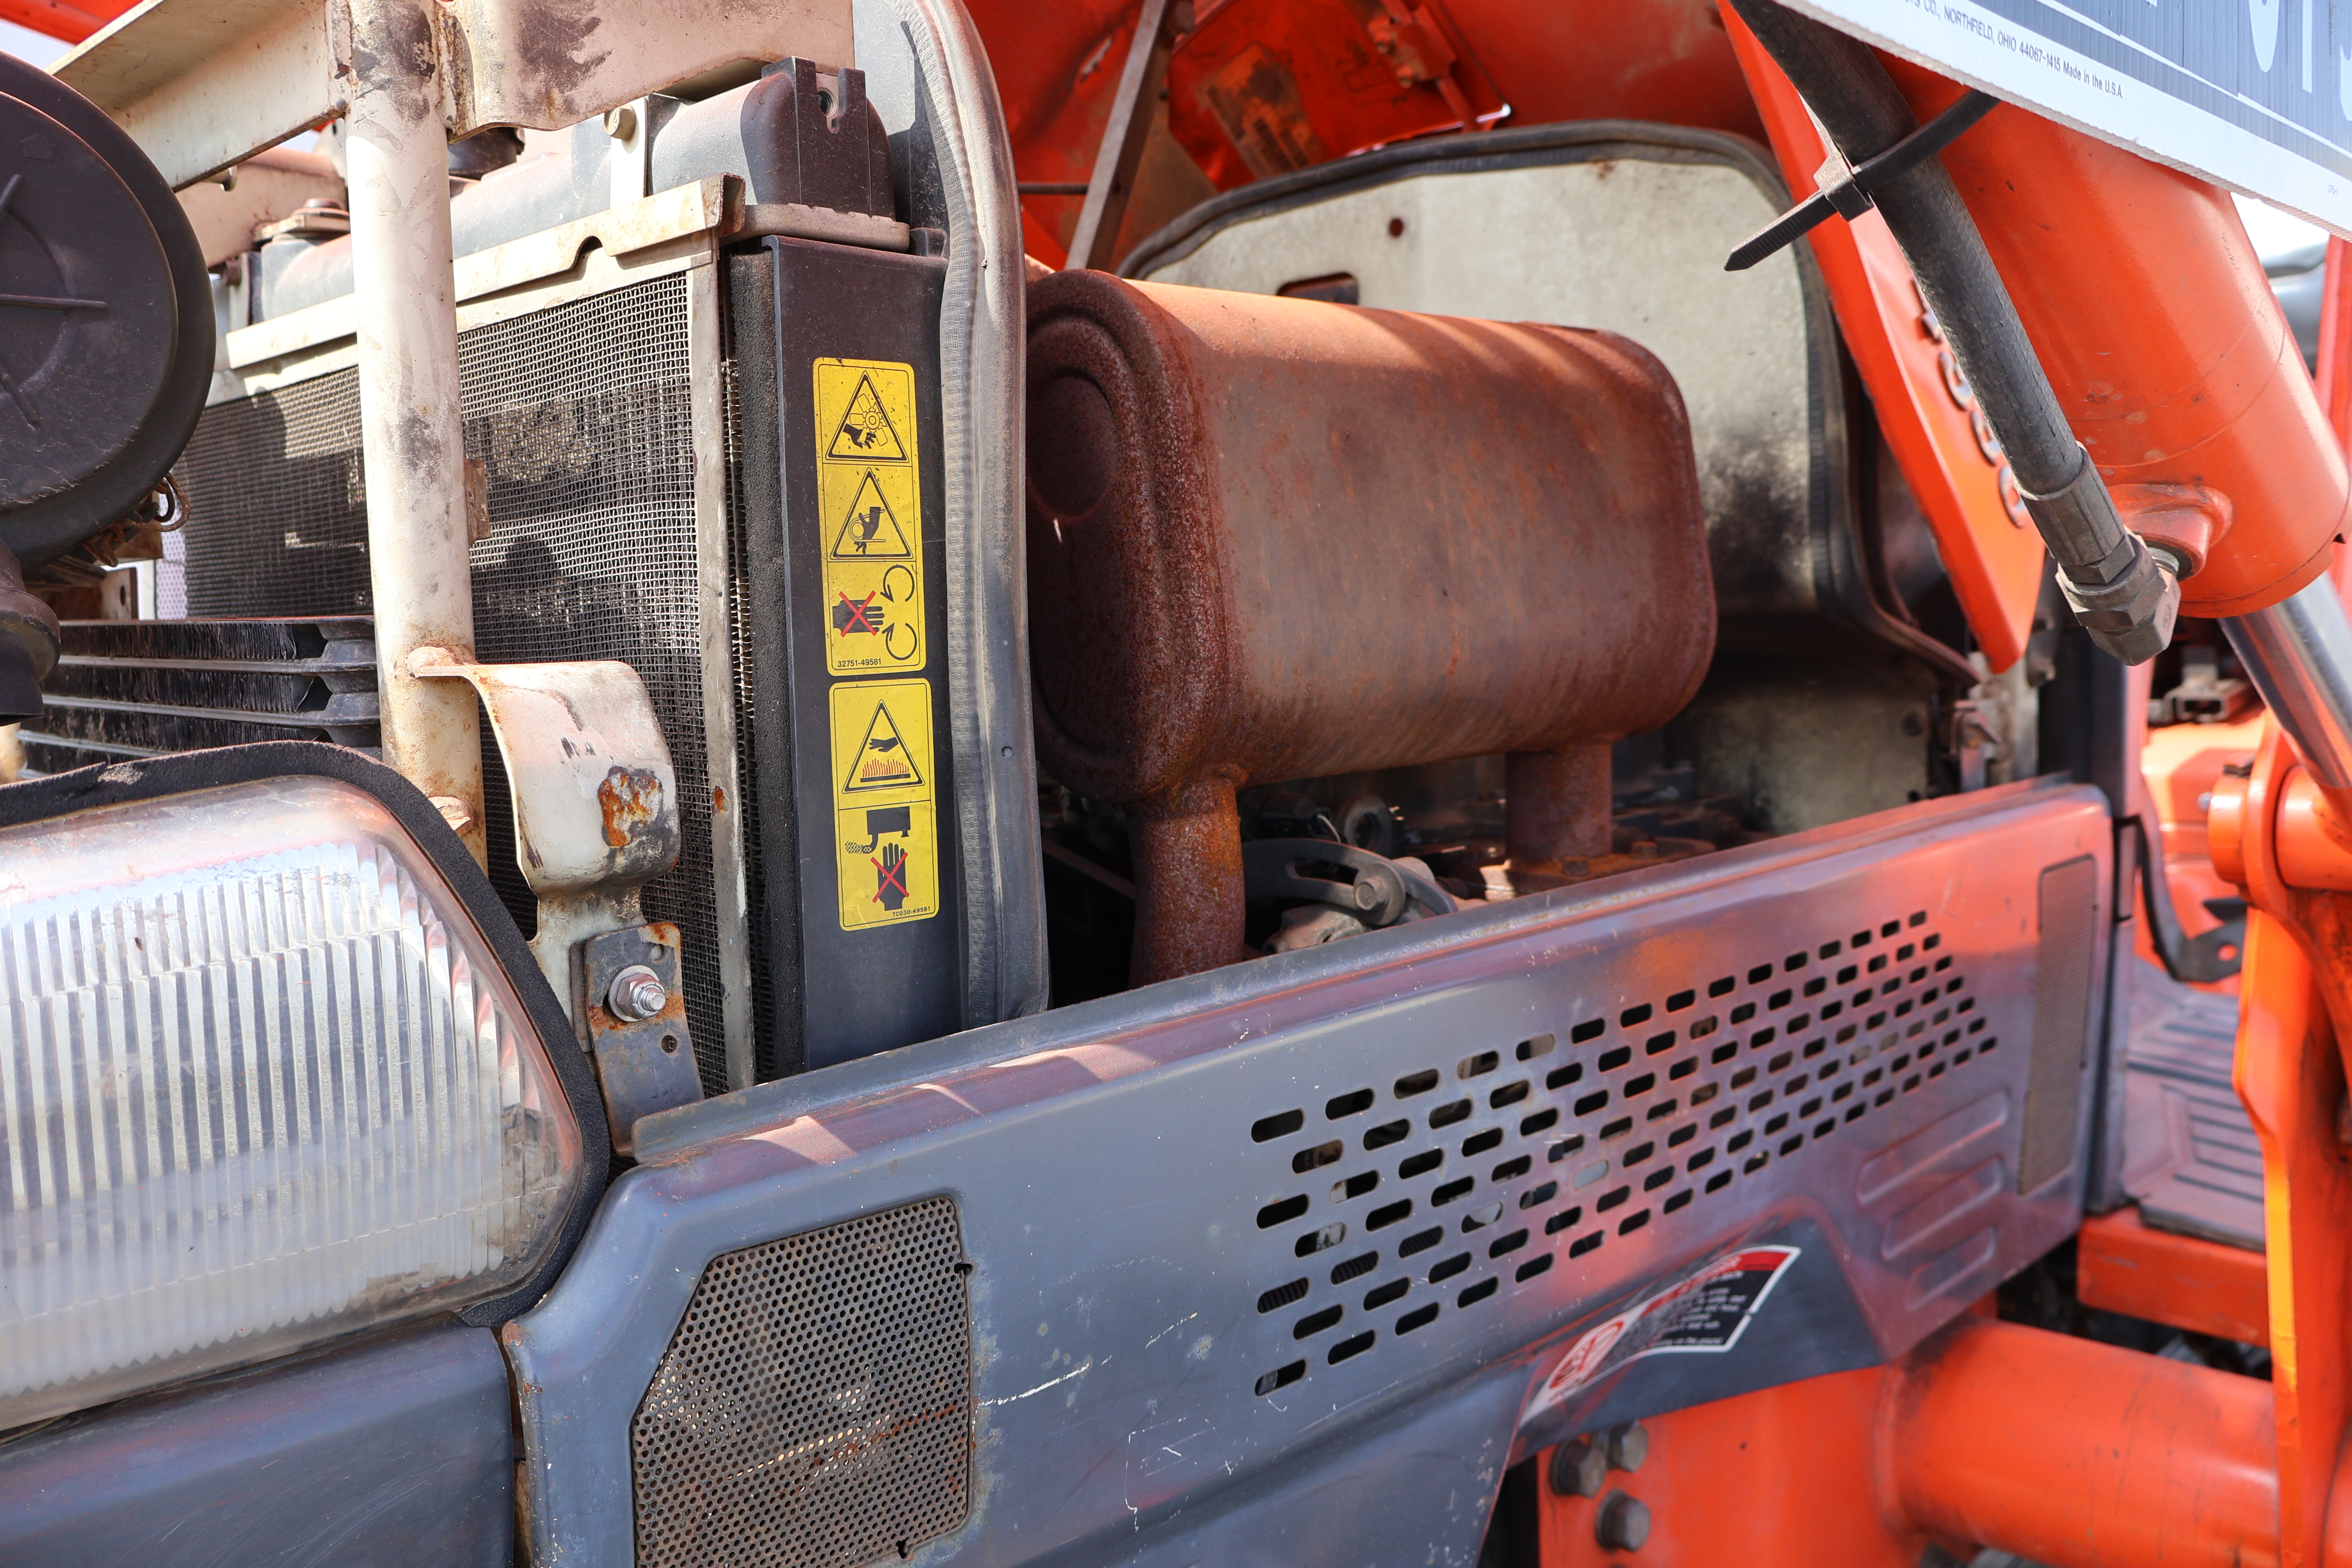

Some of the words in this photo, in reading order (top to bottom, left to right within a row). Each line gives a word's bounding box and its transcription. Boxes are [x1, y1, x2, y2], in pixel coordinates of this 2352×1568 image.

[1944, 4, 1995, 45] NORTHFIELD,
[1997, 30, 2016, 52] OHIO
[2020, 40, 2061, 72] 44067-1415
[2063, 60, 2081, 81] Made
[2083, 69, 2089, 85] in
[2092, 73, 2102, 90] the
[2105, 79, 2123, 99] U.S.A.
[837, 658, 881, 668] 32751-49581
[892, 906, 931, 917] TC030-49581
